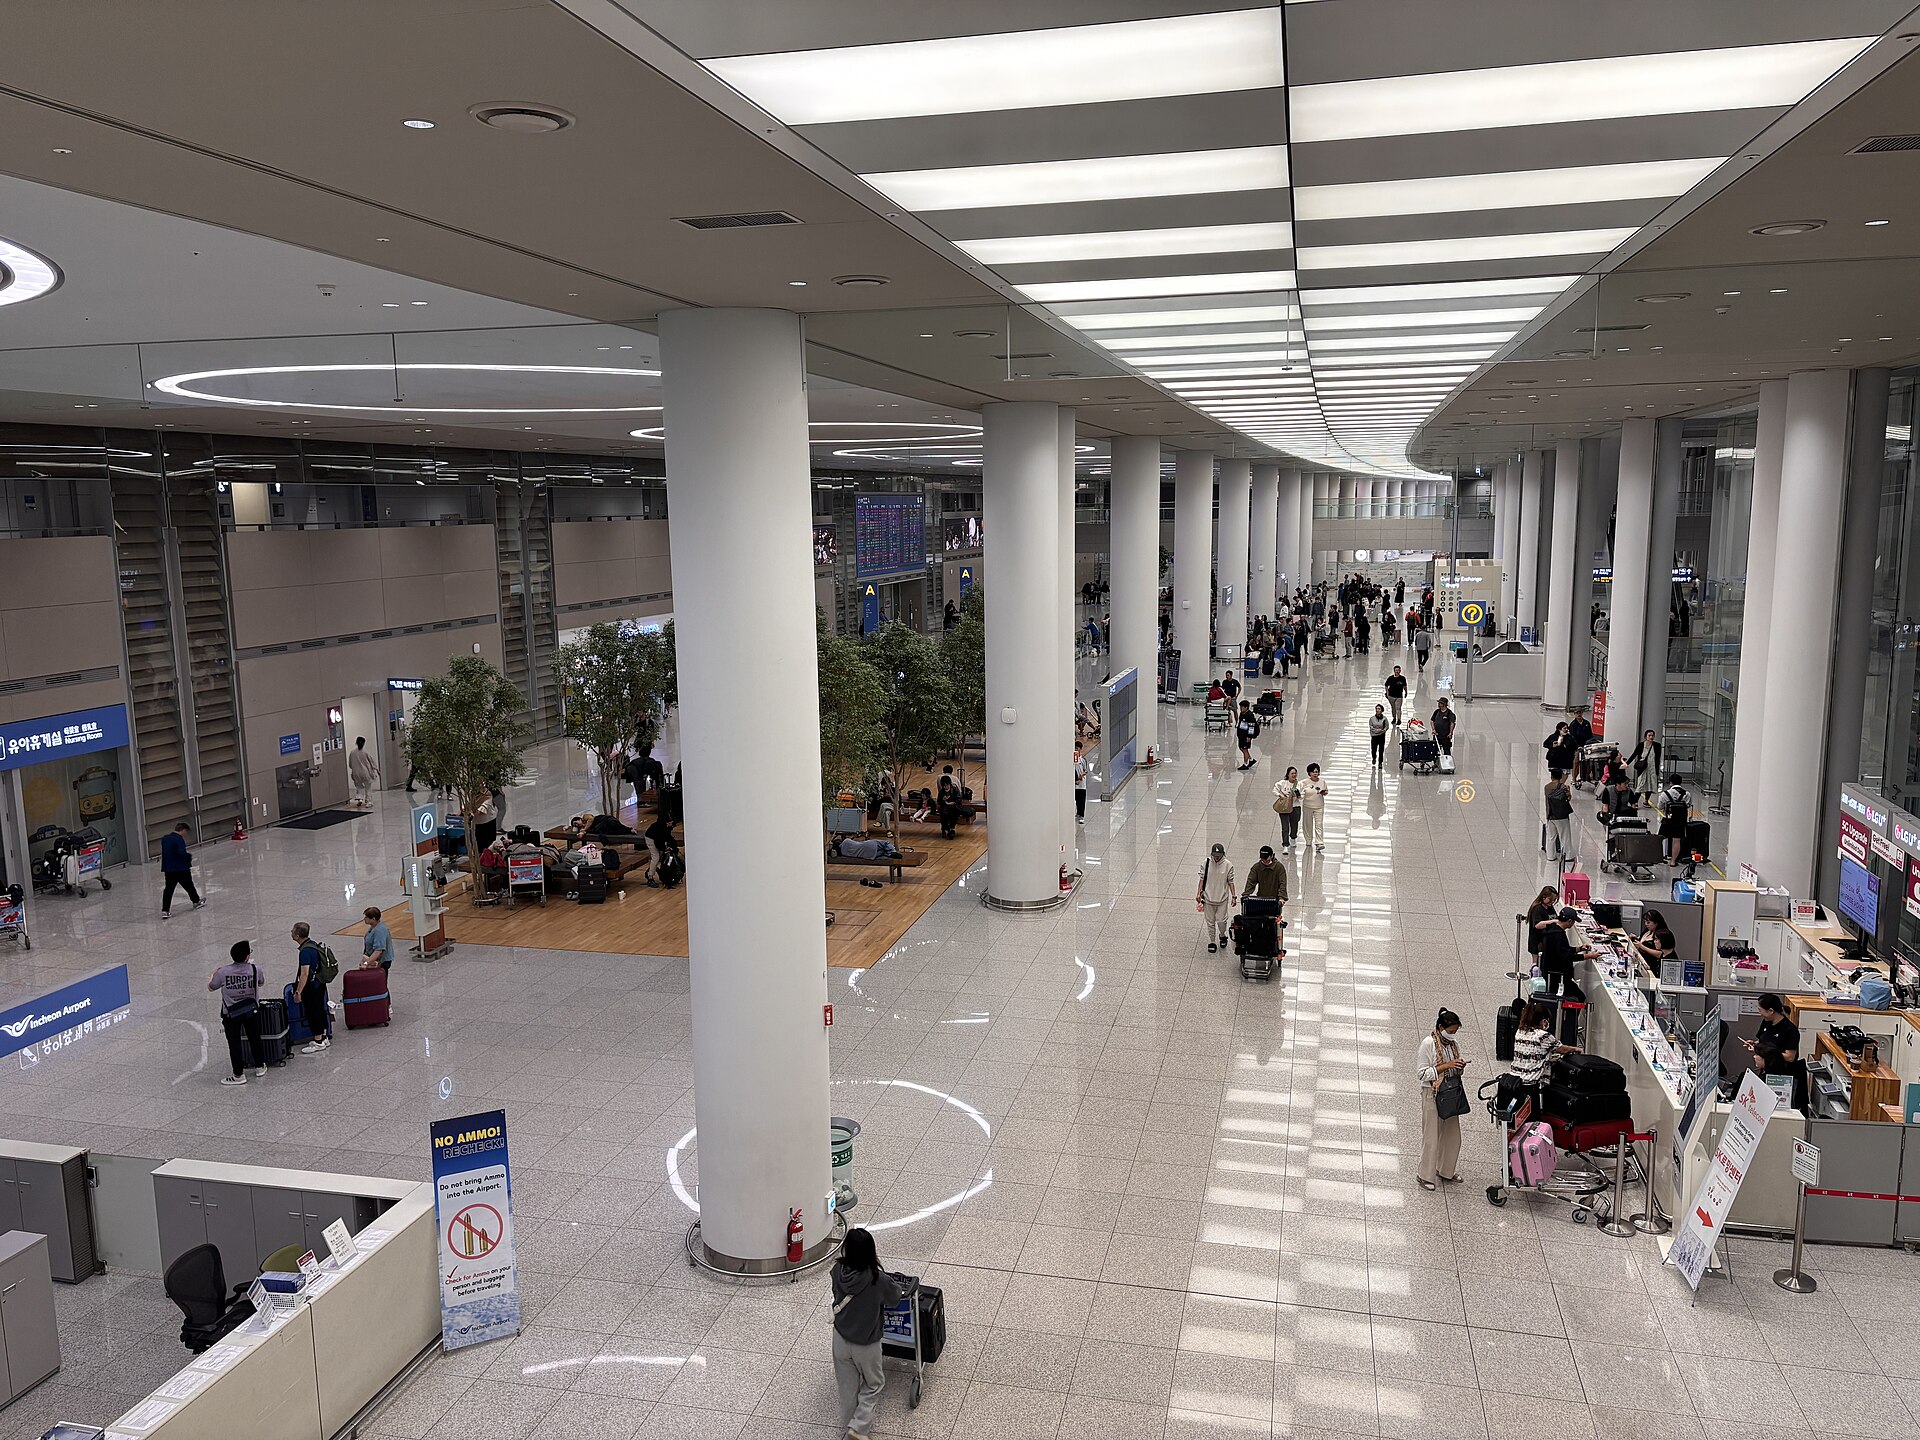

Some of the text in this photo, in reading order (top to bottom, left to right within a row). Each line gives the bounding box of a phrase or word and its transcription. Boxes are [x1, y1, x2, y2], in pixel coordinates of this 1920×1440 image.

[961, 569, 970, 578] A
[865, 584, 875, 596] A
[7, 730, 63, 755] 유아휴게실
[65, 732, 103, 745] Nursing Room
[30, 997, 91, 1029] Incheon Airport
[434, 1126, 500, 1148] NO AMMO!
[442, 1137, 505, 1159] RECHECK!
[440, 1173, 505, 1191] Do not bring Ammo
[446, 1183, 502, 1199] into the Airport.
[472, 1271, 490, 1279] Ammo
[499, 1265, 511, 1274] your
[452, 1274, 506, 1292] person and luggage
[457, 1282, 502, 1297] before traveling
[471, 1318, 511, 1332] Incheon Airport
